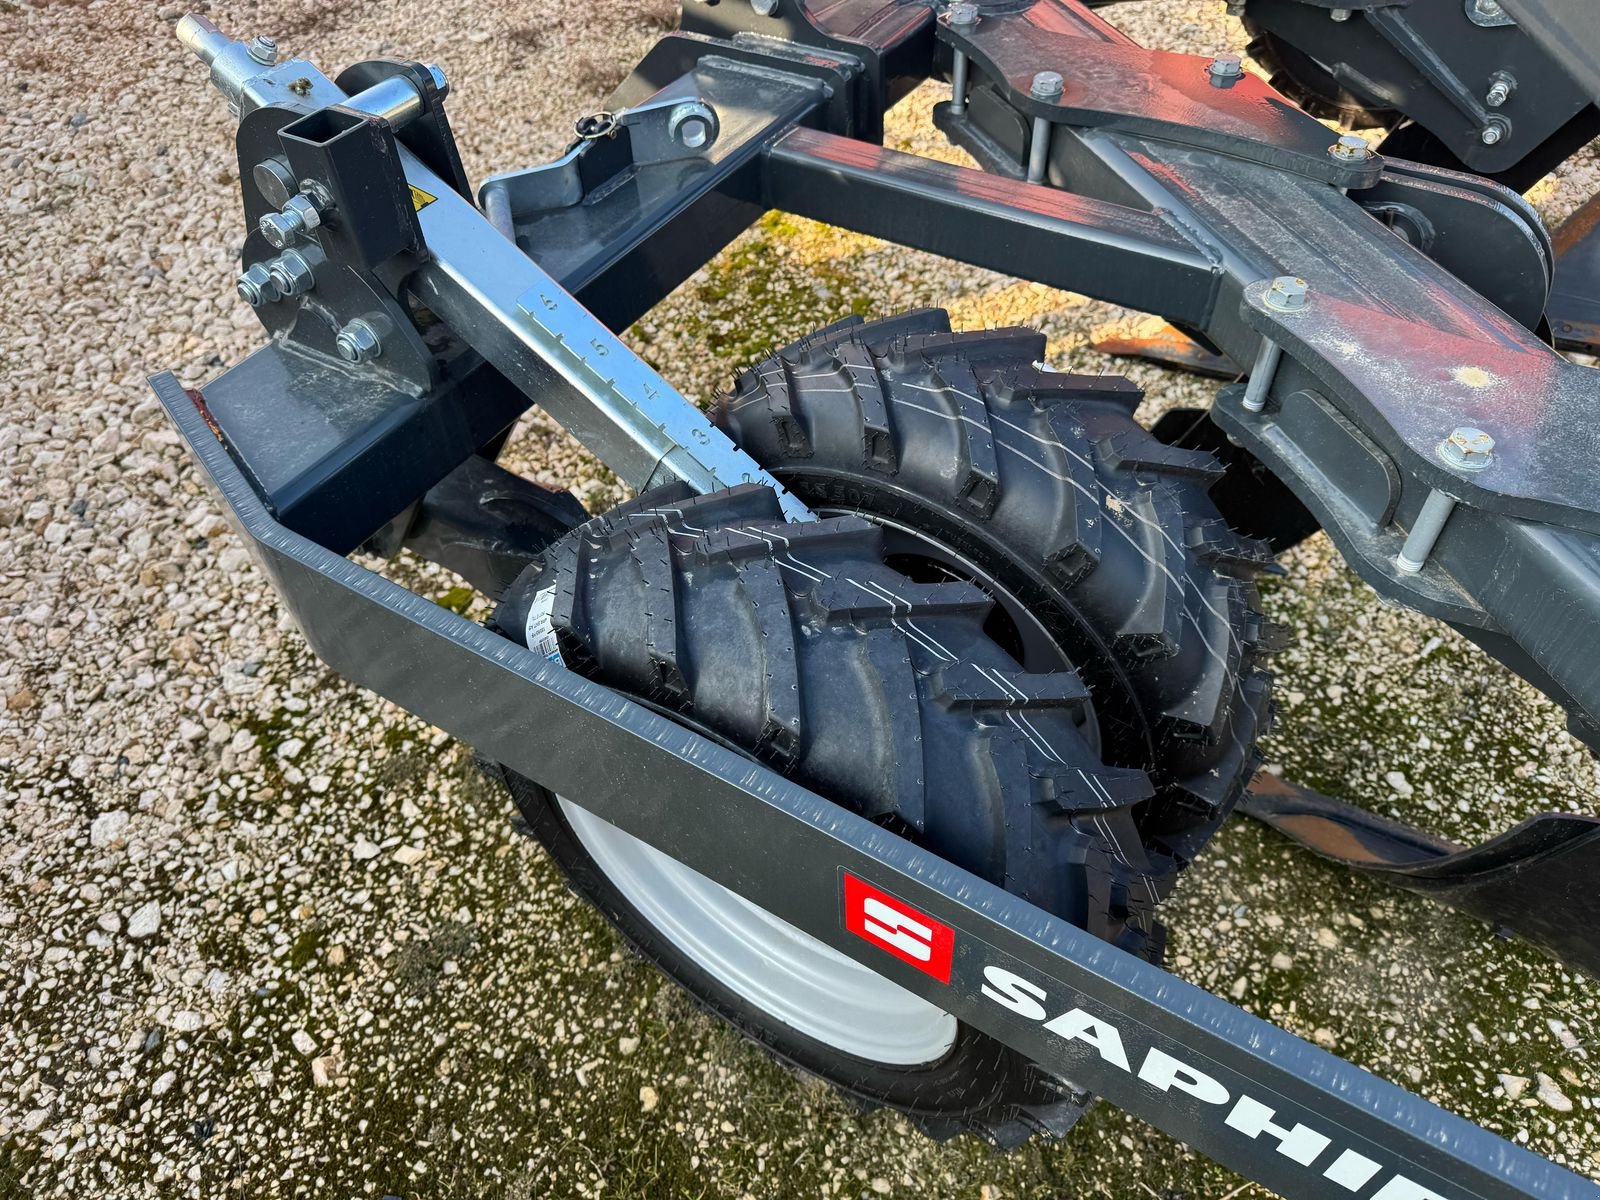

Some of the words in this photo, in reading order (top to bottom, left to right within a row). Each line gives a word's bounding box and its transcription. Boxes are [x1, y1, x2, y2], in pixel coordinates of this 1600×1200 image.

[590, 338, 610, 356] 5
[643, 383, 660, 400] 4
[692, 428, 711, 446] 3
